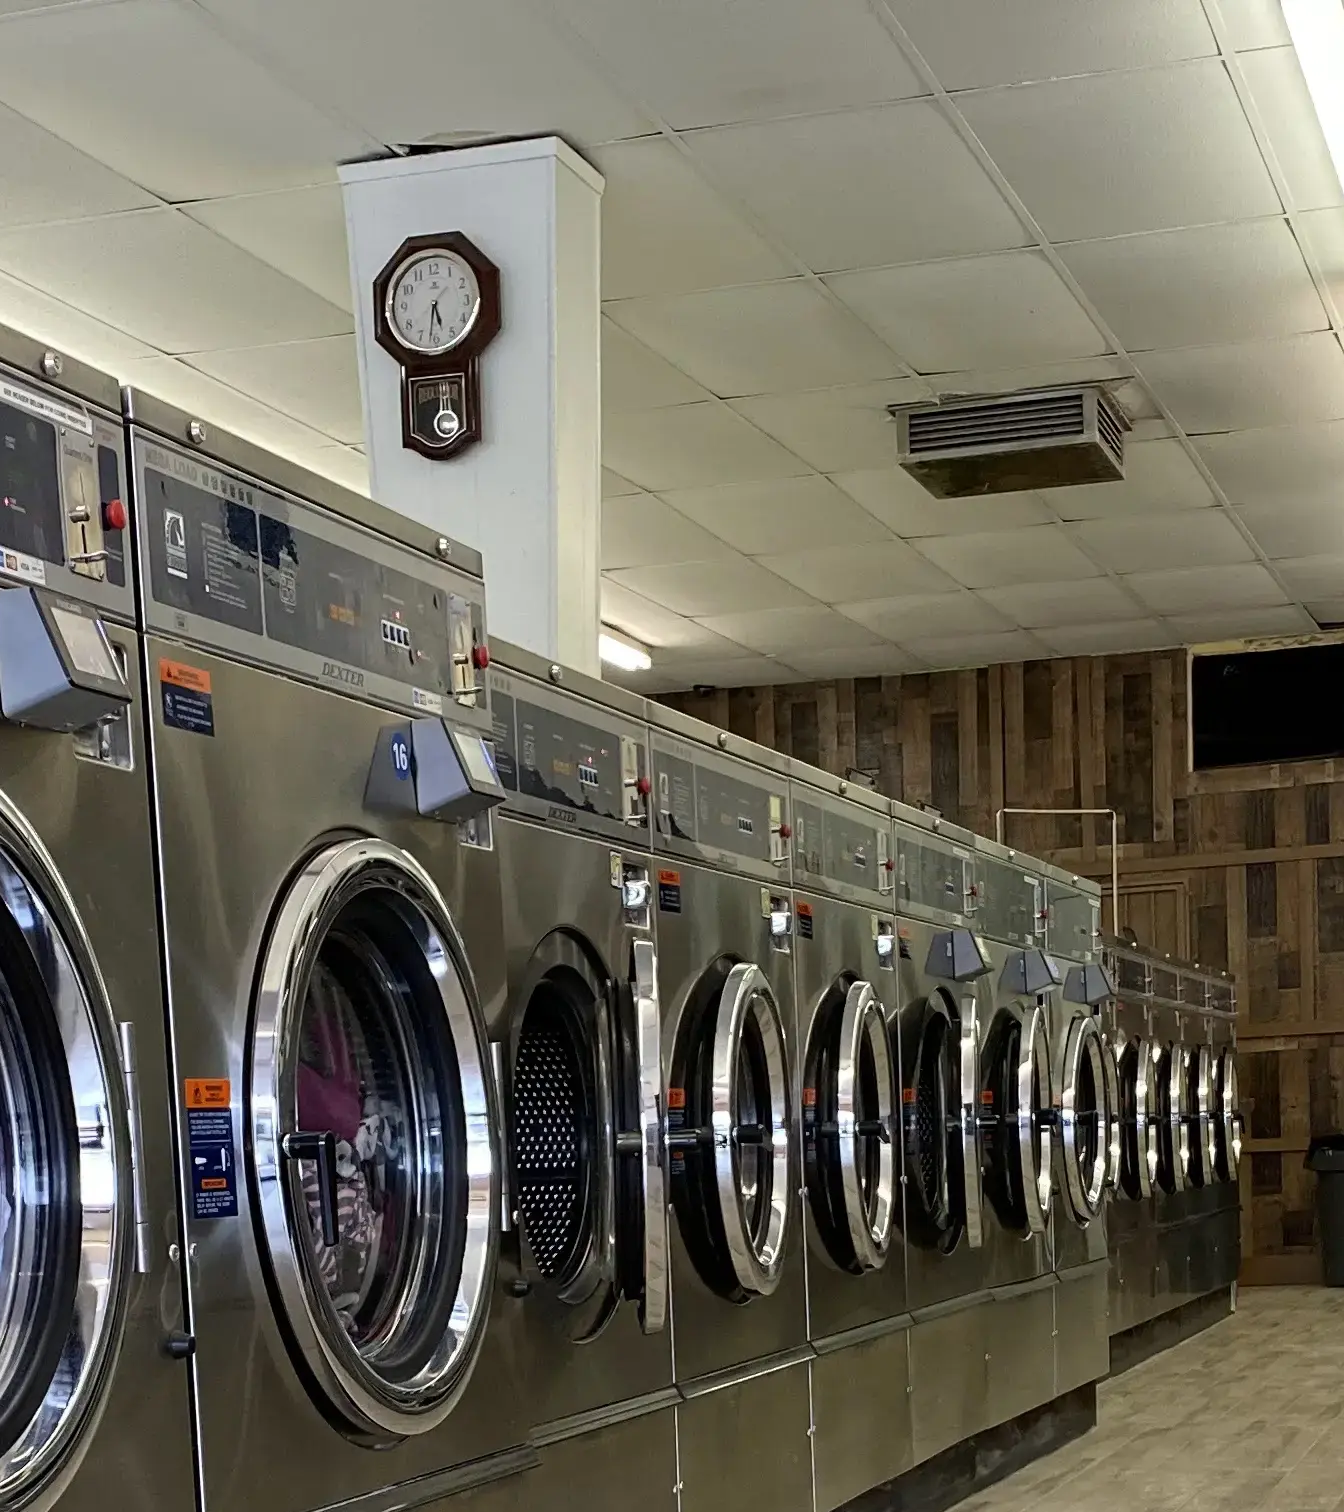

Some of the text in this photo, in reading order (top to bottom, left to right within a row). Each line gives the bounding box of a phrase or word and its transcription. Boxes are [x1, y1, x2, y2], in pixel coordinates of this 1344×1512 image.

[414, 269, 423, 282] 11
[428, 263, 440, 276] 12
[447, 266, 452, 278] 1
[458, 277, 466, 290] 2
[402, 284, 414, 296] 10
[463, 294, 470, 306] 3
[400, 301, 408, 313] 9
[459, 312, 467, 324] 4
[405, 319, 413, 331] 8
[417, 329, 424, 342] 7
[448, 326, 456, 338] 5
[432, 333, 441, 344] 6
[322, 661, 365, 688] DEXTER
[392, 742, 408, 771] 16
